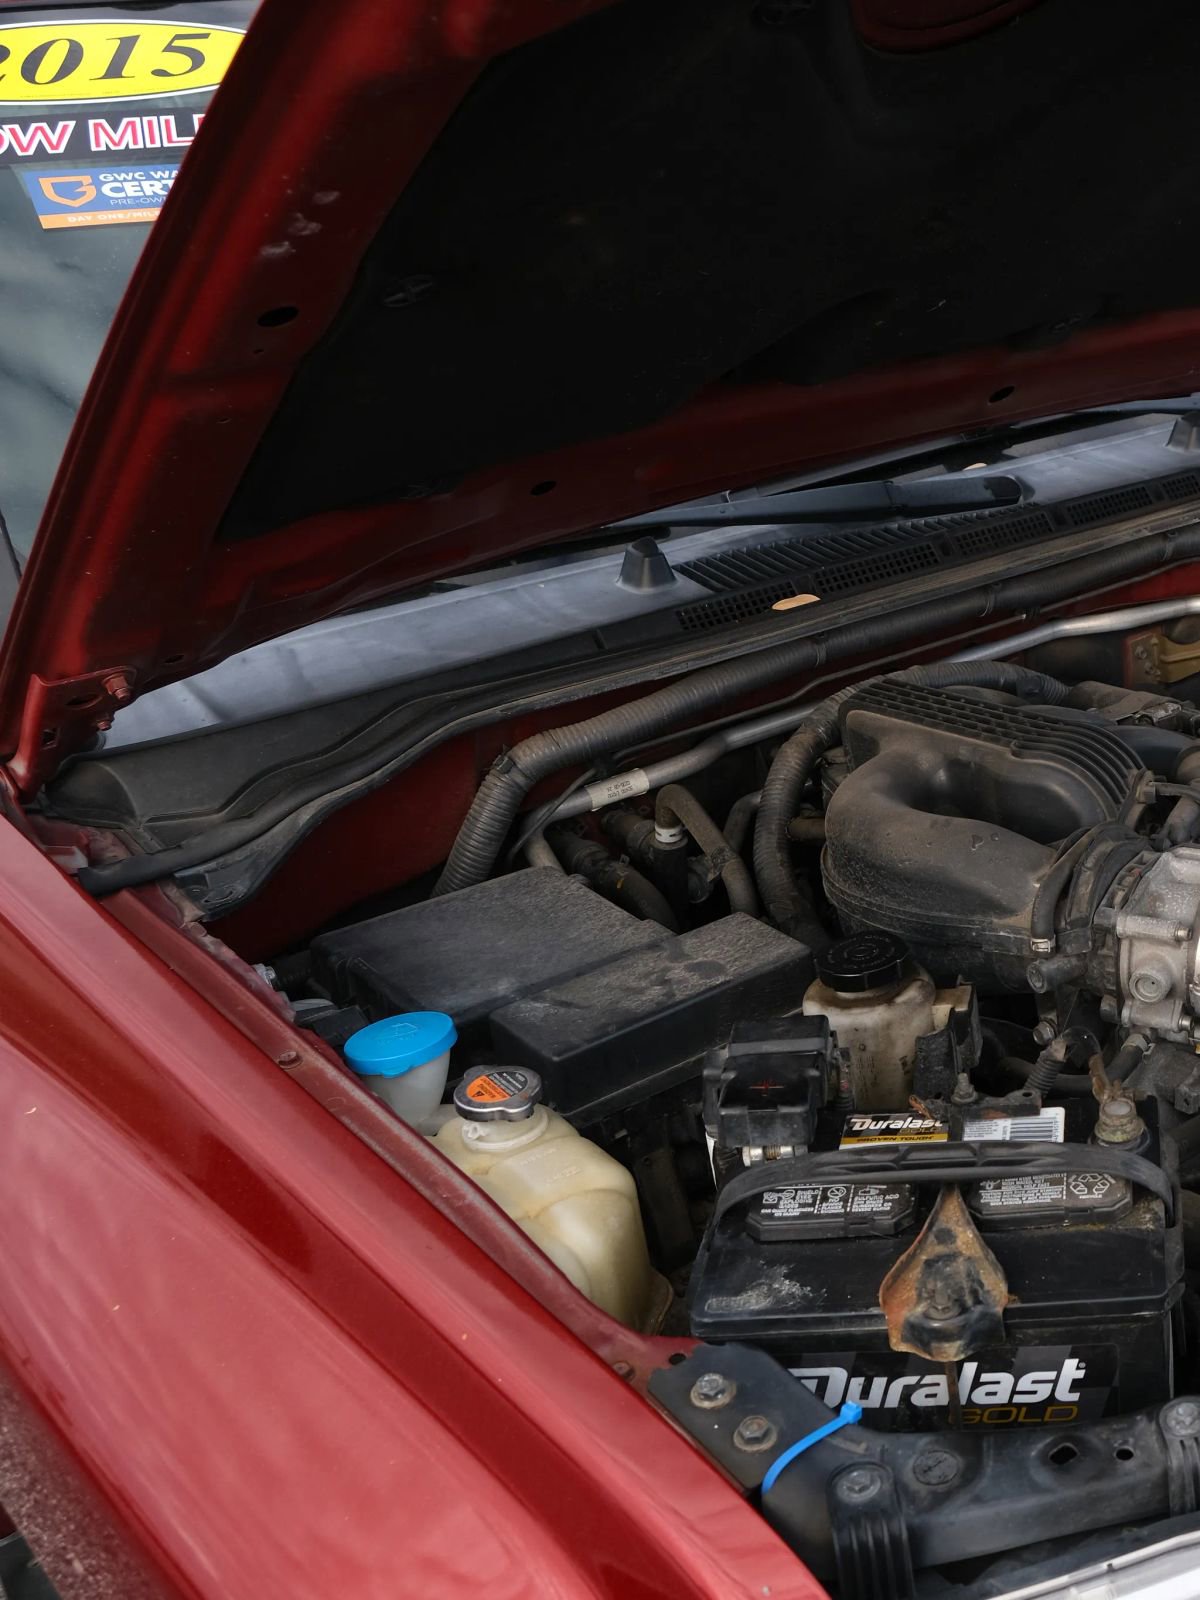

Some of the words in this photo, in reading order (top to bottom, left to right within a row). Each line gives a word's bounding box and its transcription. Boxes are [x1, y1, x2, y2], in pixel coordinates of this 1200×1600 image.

[0, 33, 211, 86] 015
[99, 171, 146, 182] GWC
[110, 196, 167, 206] PRE-OW
[66, 214, 93, 223] DAY
[949, 1404, 1079, 1424] GOLD
